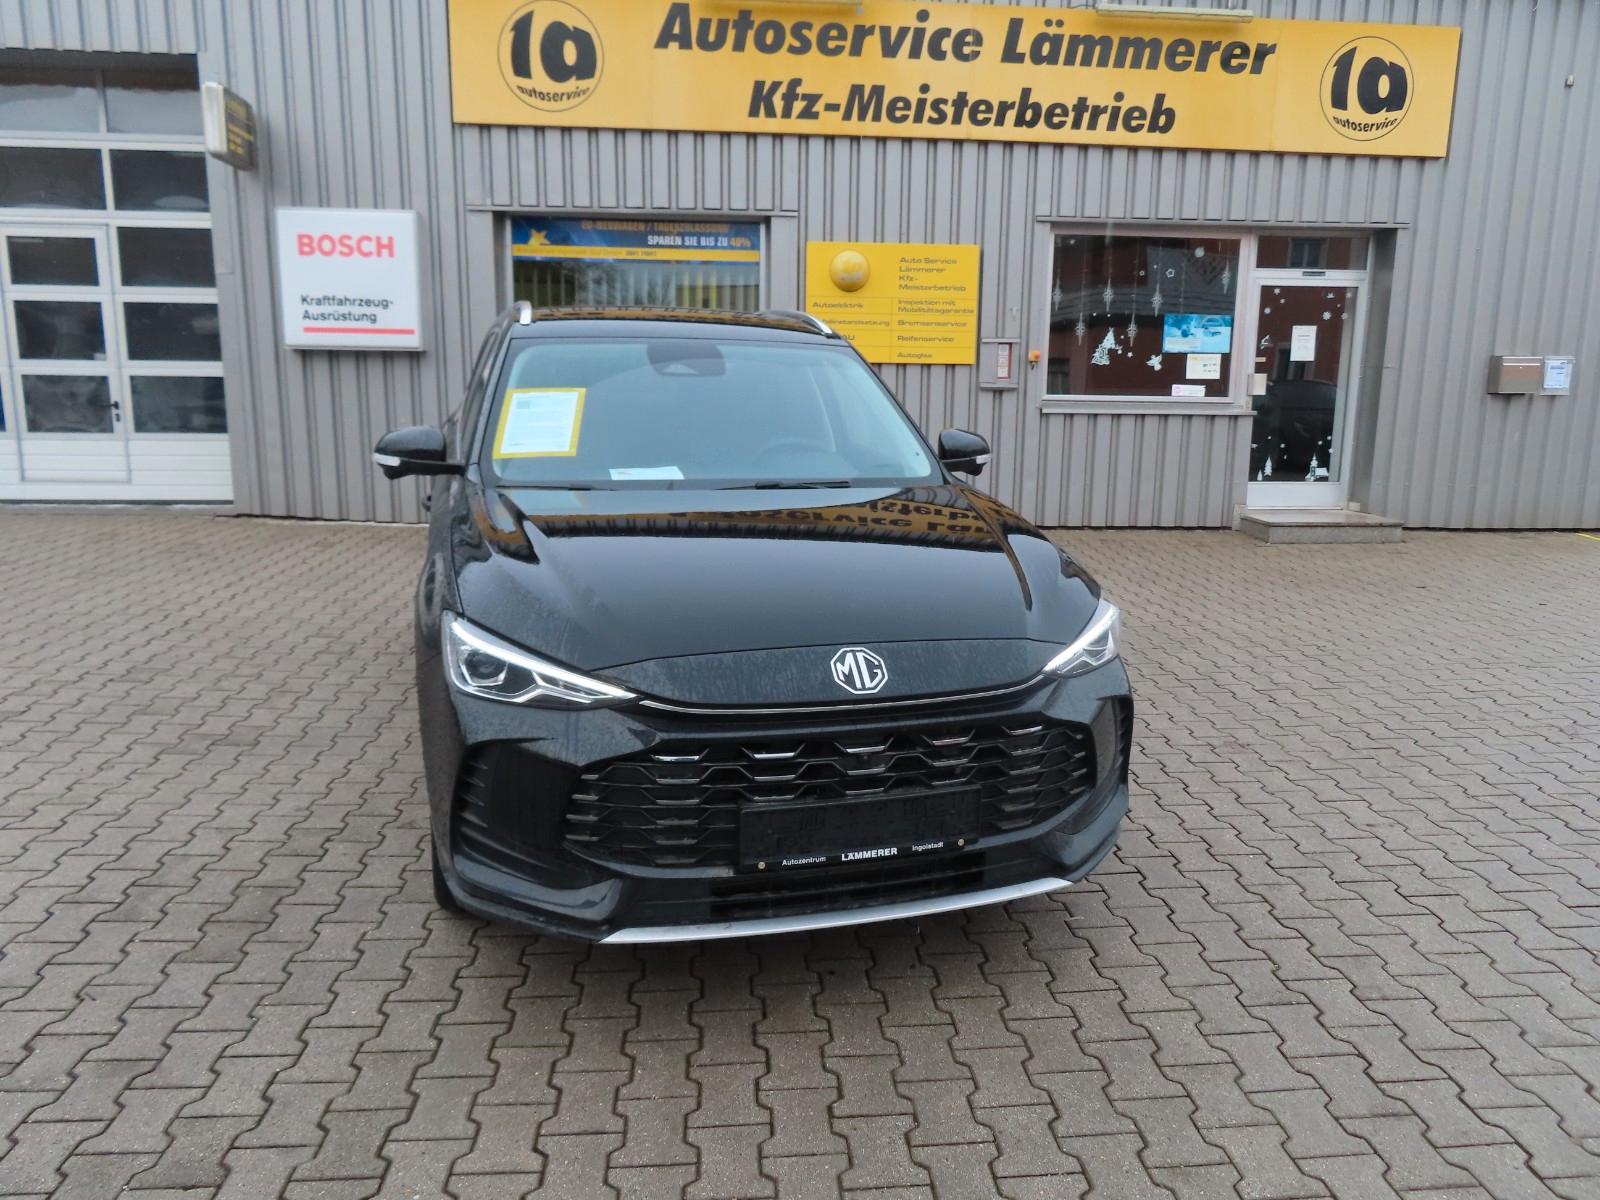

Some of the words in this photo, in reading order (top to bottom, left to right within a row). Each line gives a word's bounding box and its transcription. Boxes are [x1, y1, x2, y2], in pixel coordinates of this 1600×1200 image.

[509, 10, 597, 83] 1a
[653, 2, 983, 62] Autoservice
[1001, 17, 1277, 75] Lämmerer
[1331, 46, 1408, 115] 1a
[516, 84, 591, 102] autoservice
[748, 77, 1176, 135] Kfz-Meisterbetrieb
[1332, 116, 1398, 132] autoservice
[296, 233, 395, 258] BOSCH
[647, 235, 682, 246] SPAREN
[684, 235, 698, 247] SIE
[700, 236, 715, 247] BIS
[717, 236, 728, 247] ZU
[899, 257, 922, 265] Auto
[923, 257, 957, 265] Service
[898, 284, 966, 292] Meisterbetrieb
[300, 295, 394, 310] Kraftfahrzeug-
[302, 309, 377, 325] Ausrüstung
[897, 335, 954, 343] Reifenservice
[835, 651, 883, 689] MG
[781, 854, 827, 866] Autozentrum
[841, 847, 898, 861] LÄMMERER
[911, 840, 944, 852] Ingolstadt
